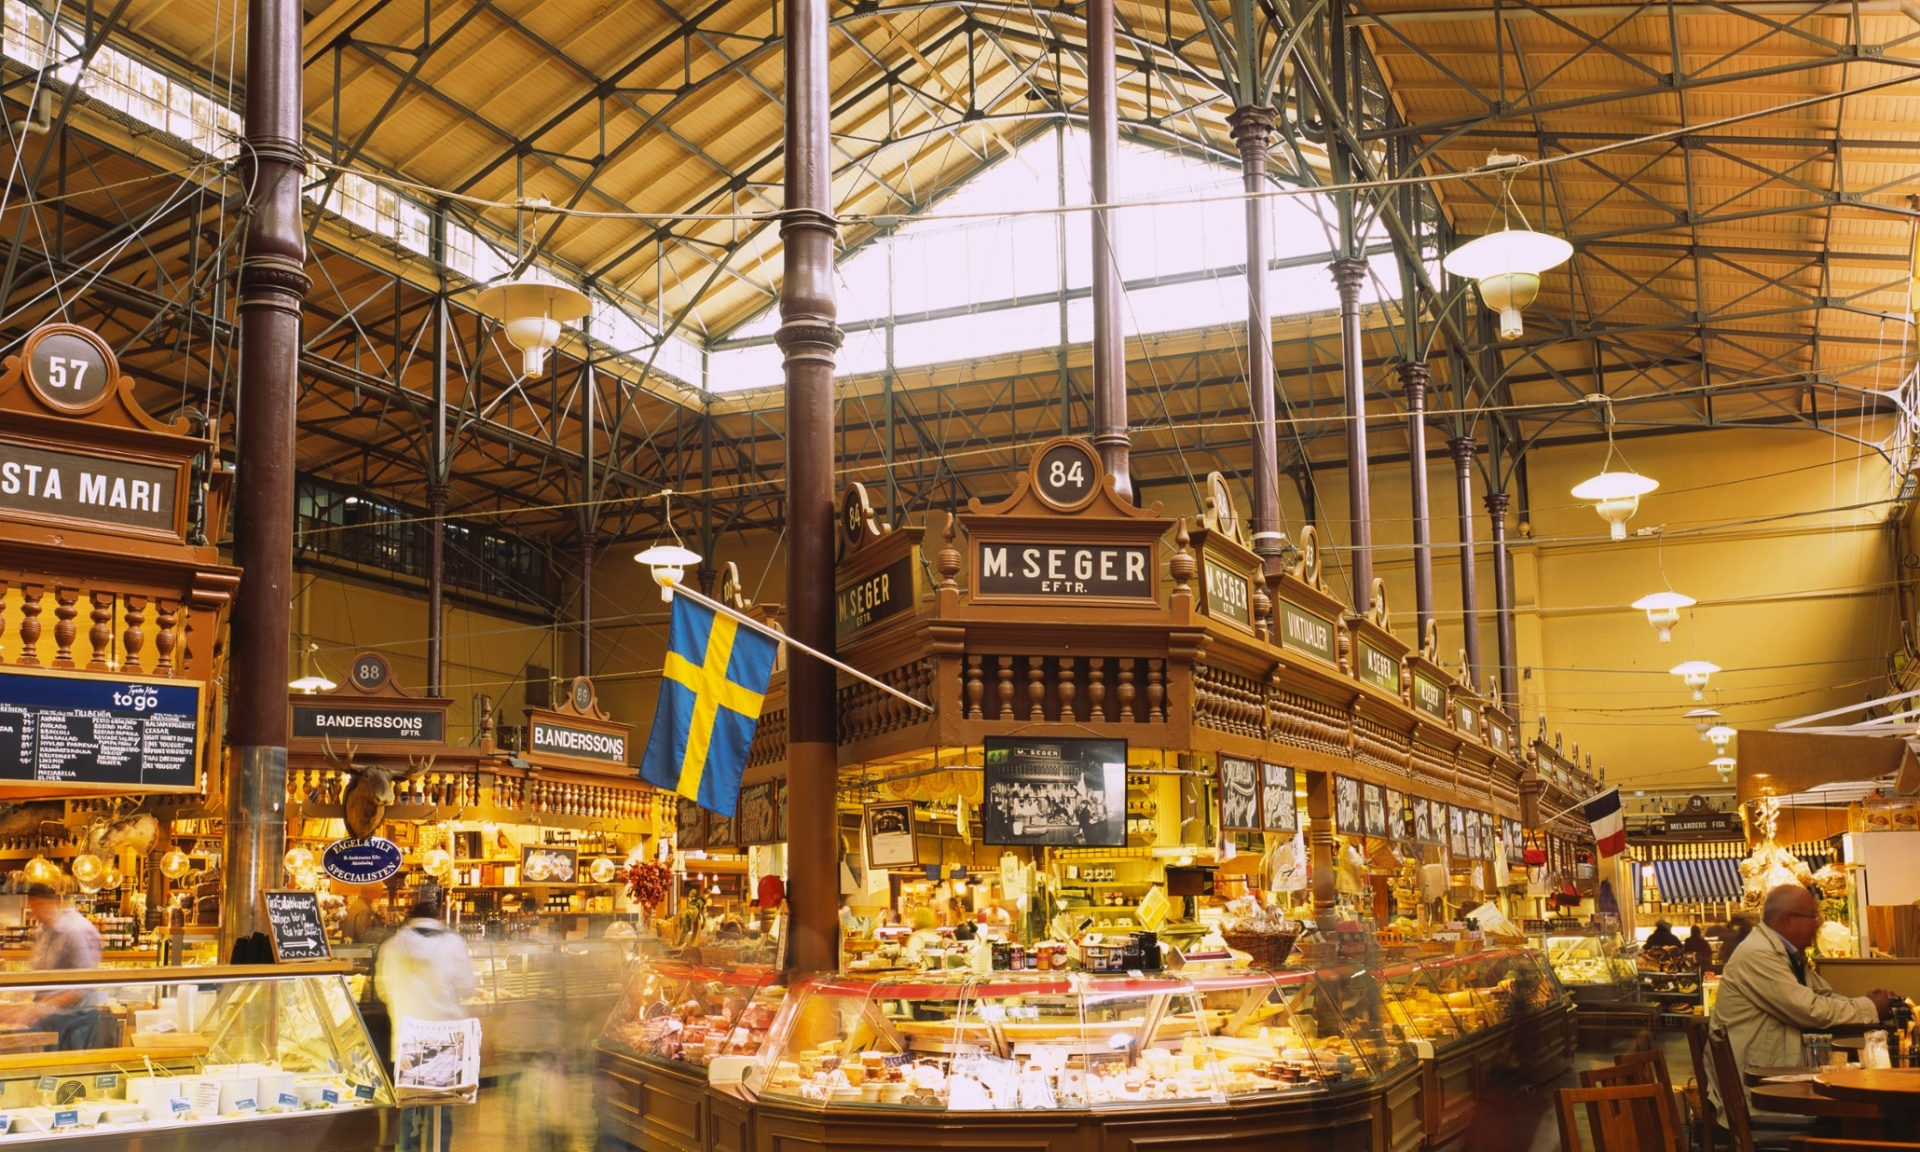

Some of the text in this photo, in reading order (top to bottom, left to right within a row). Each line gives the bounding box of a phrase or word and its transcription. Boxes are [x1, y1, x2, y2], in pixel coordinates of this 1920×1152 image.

[49, 356, 89, 390] 57
[1, 462, 161, 513] STA MARI
[1049, 460, 1084, 488] 84
[850, 503, 860, 530] 84
[983, 547, 1145, 581] M. SEGER
[850, 573, 890, 616] SEGER
[1042, 581, 1088, 593] EFTR.
[1216, 570, 1247, 610] SEGER
[360, 665, 379, 679] 88
[113, 691, 158, 711] to go
[577, 688, 587, 702] 89
[316, 715, 422, 729] B.ANDERSSONS
[535, 727, 623, 756] B.ANDERSSONS
[1670, 822, 1706, 830] MELANDERS
[328, 862, 396, 882] SPECIALISTEN
